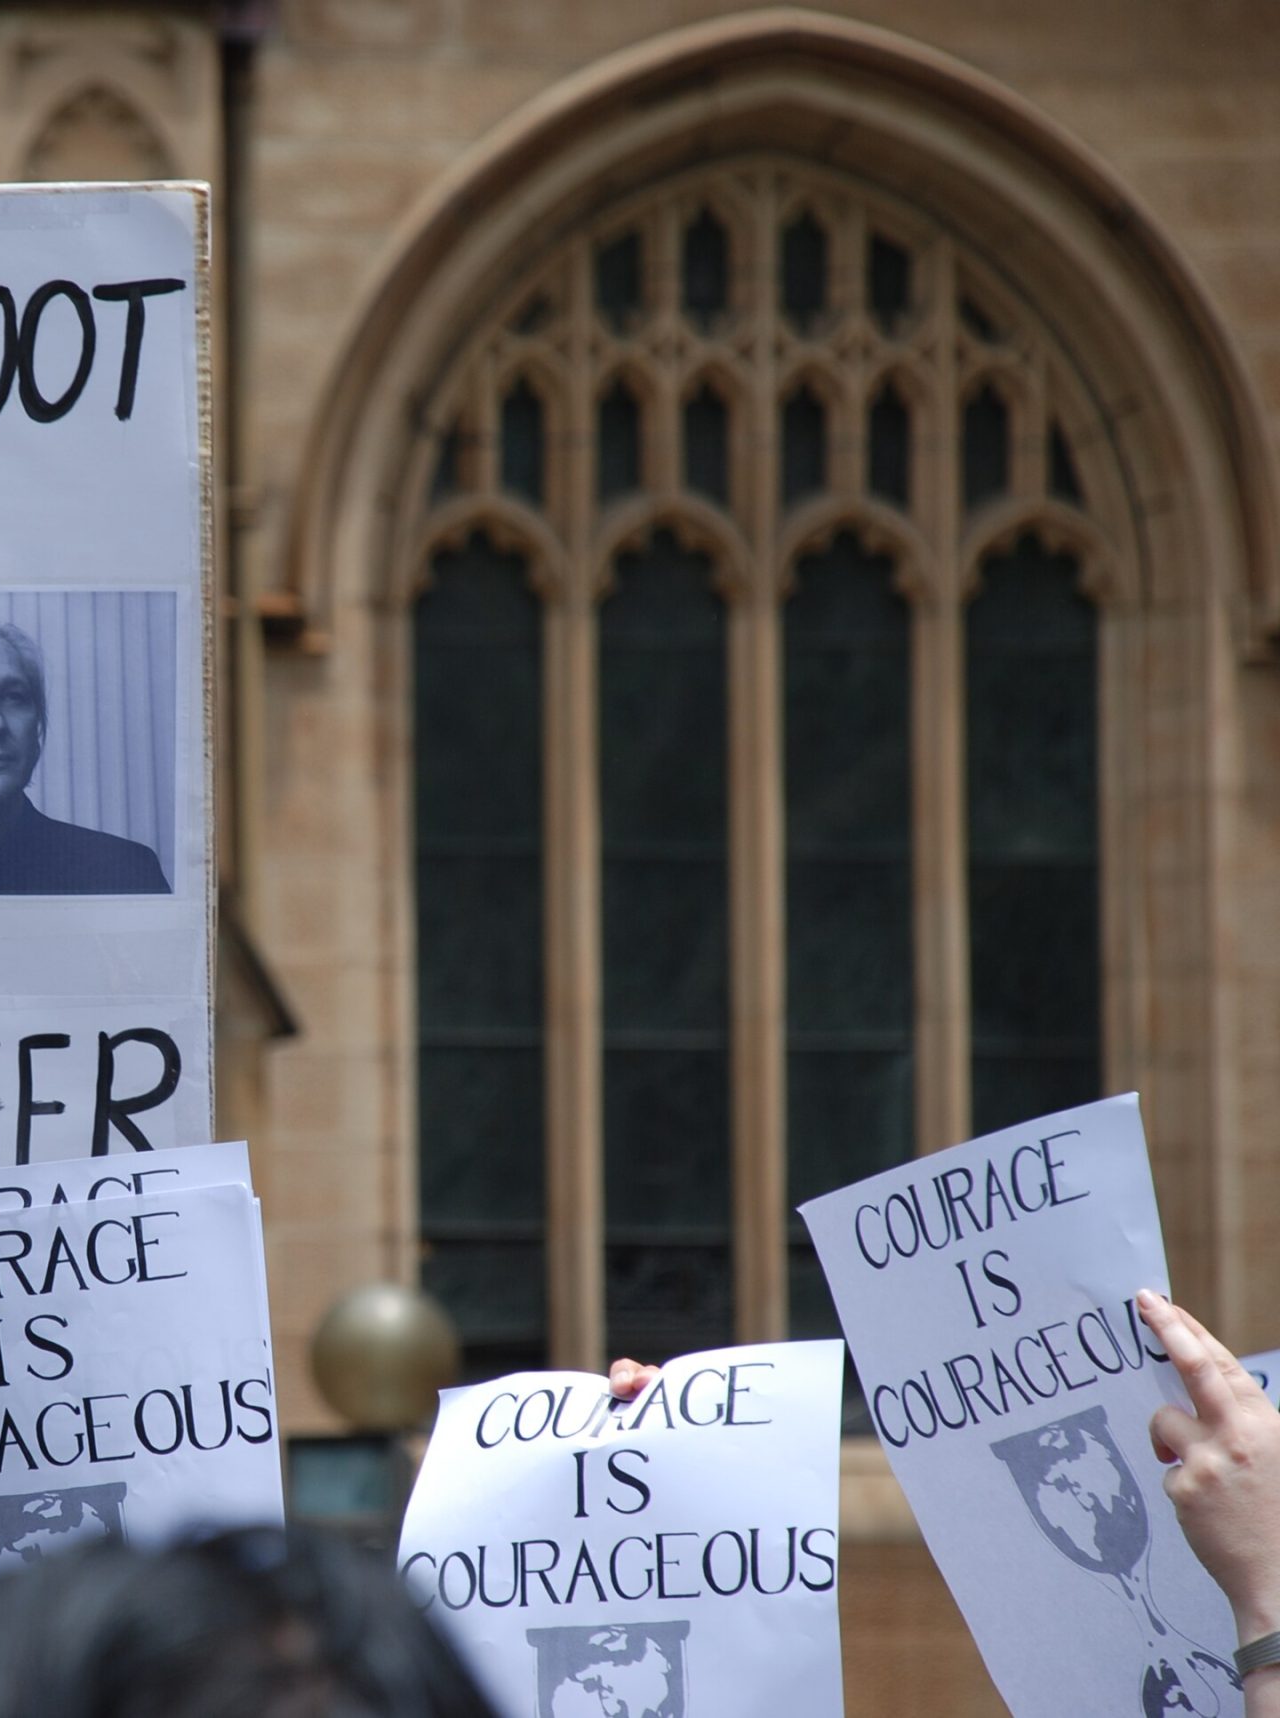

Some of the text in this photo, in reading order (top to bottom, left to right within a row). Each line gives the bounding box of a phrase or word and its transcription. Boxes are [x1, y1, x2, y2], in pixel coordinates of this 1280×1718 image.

[855, 1130, 1090, 1270] COURAGE
[956, 1250, 1022, 1329] IS
[574, 1450, 651, 1518] IS
[403, 1527, 835, 1611] COURAGEOUS
